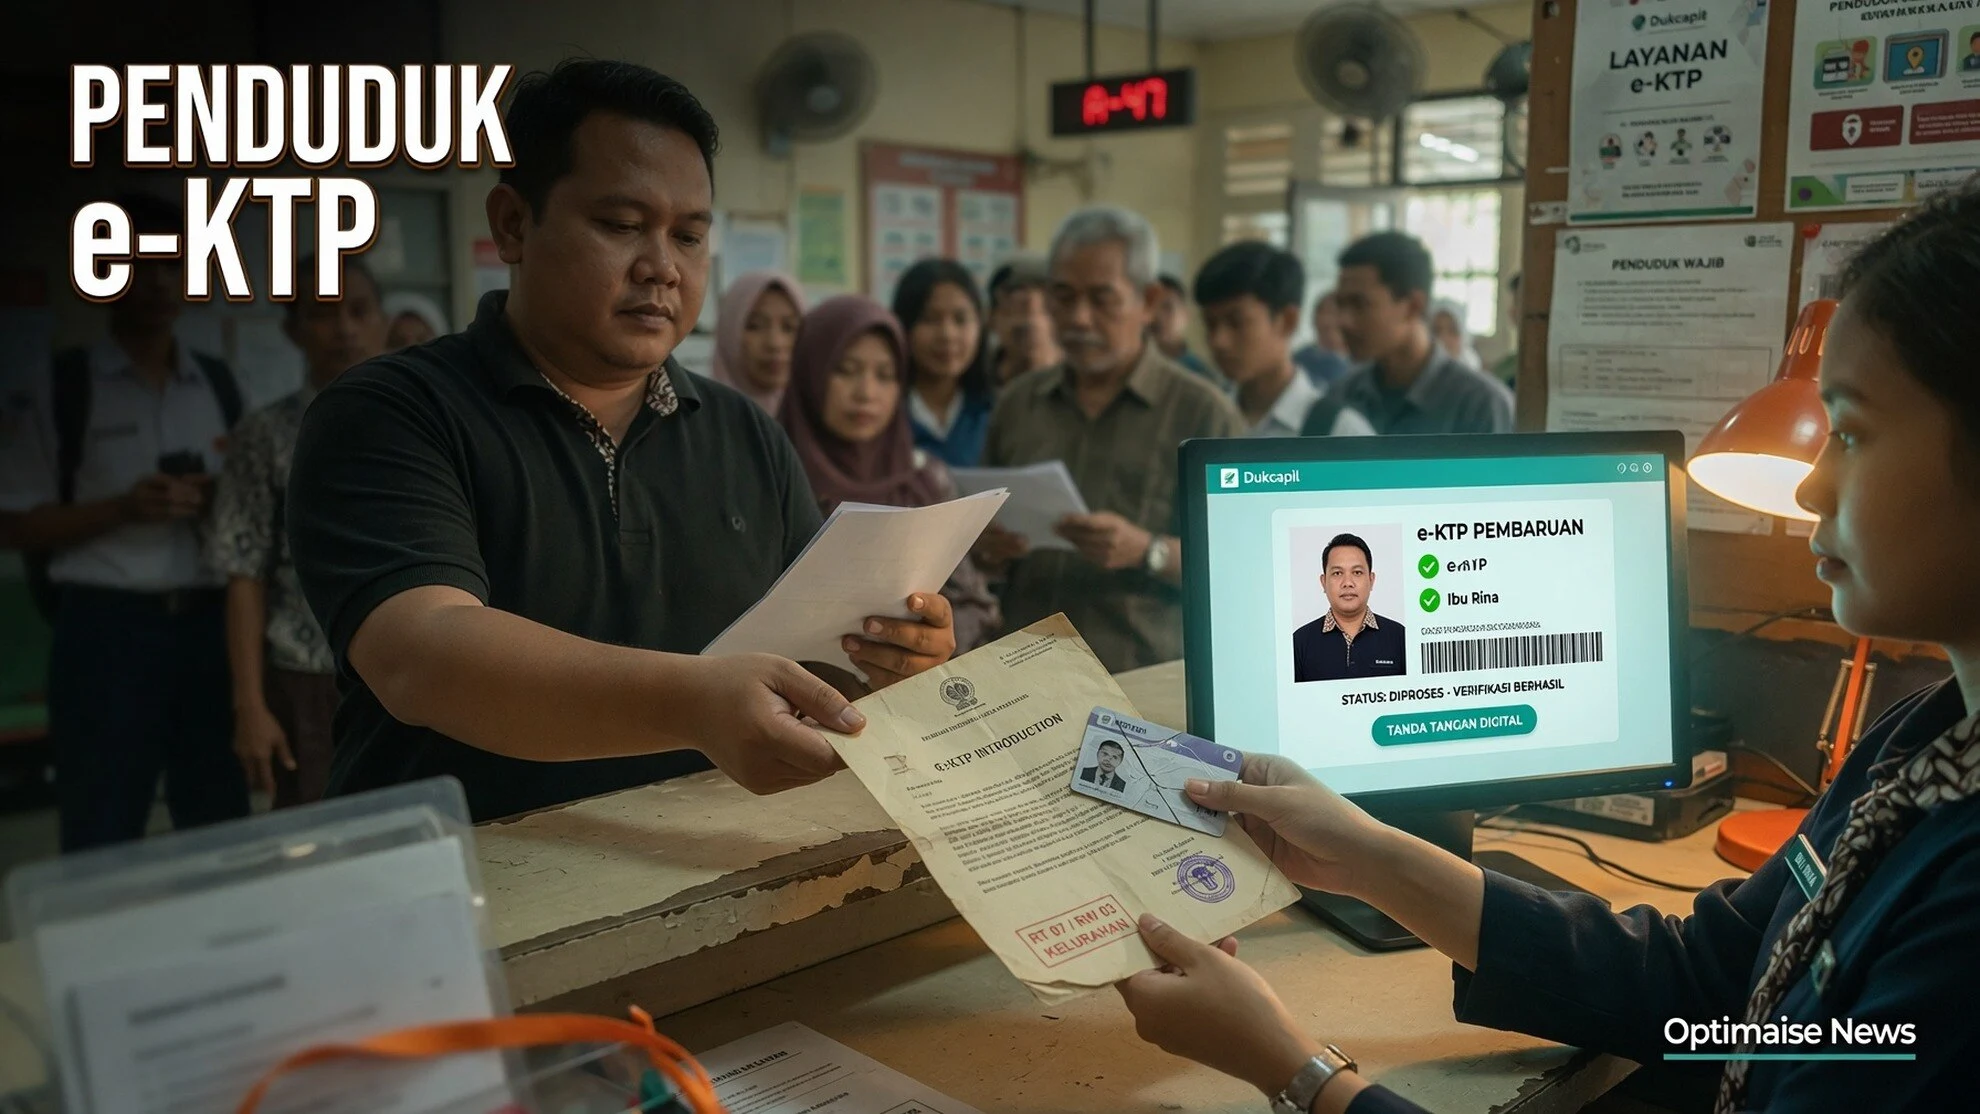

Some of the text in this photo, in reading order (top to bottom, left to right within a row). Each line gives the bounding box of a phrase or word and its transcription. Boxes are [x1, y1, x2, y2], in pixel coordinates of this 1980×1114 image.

[1609, 39, 1728, 70] LAYANAN
[1631, 69, 1703, 93] e-KTP
[1083, 78, 1167, 125] A-47
[1612, 256, 1725, 271] PENDUDUK WAJIB
[1417, 519, 1584, 541] e-KTP PEMBARUAN
[1448, 590, 1499, 606] Ibu Rina
[1342, 692, 1387, 706] STATUS:
[1389, 687, 1444, 702] DIPROSES
[1453, 682, 1511, 697] VERIFIKASI
[1514, 679, 1565, 692] BERHASIL
[974, 712, 1064, 759] INTRODUCTION
[1387, 715, 1523, 736] TANDA TANGAN DIGITAL
[1028, 929, 1048, 945] RT
[1049, 922, 1066, 937] 07
[1098, 903, 1117, 917] 03
[1043, 918, 1130, 959] KELURAHAN
